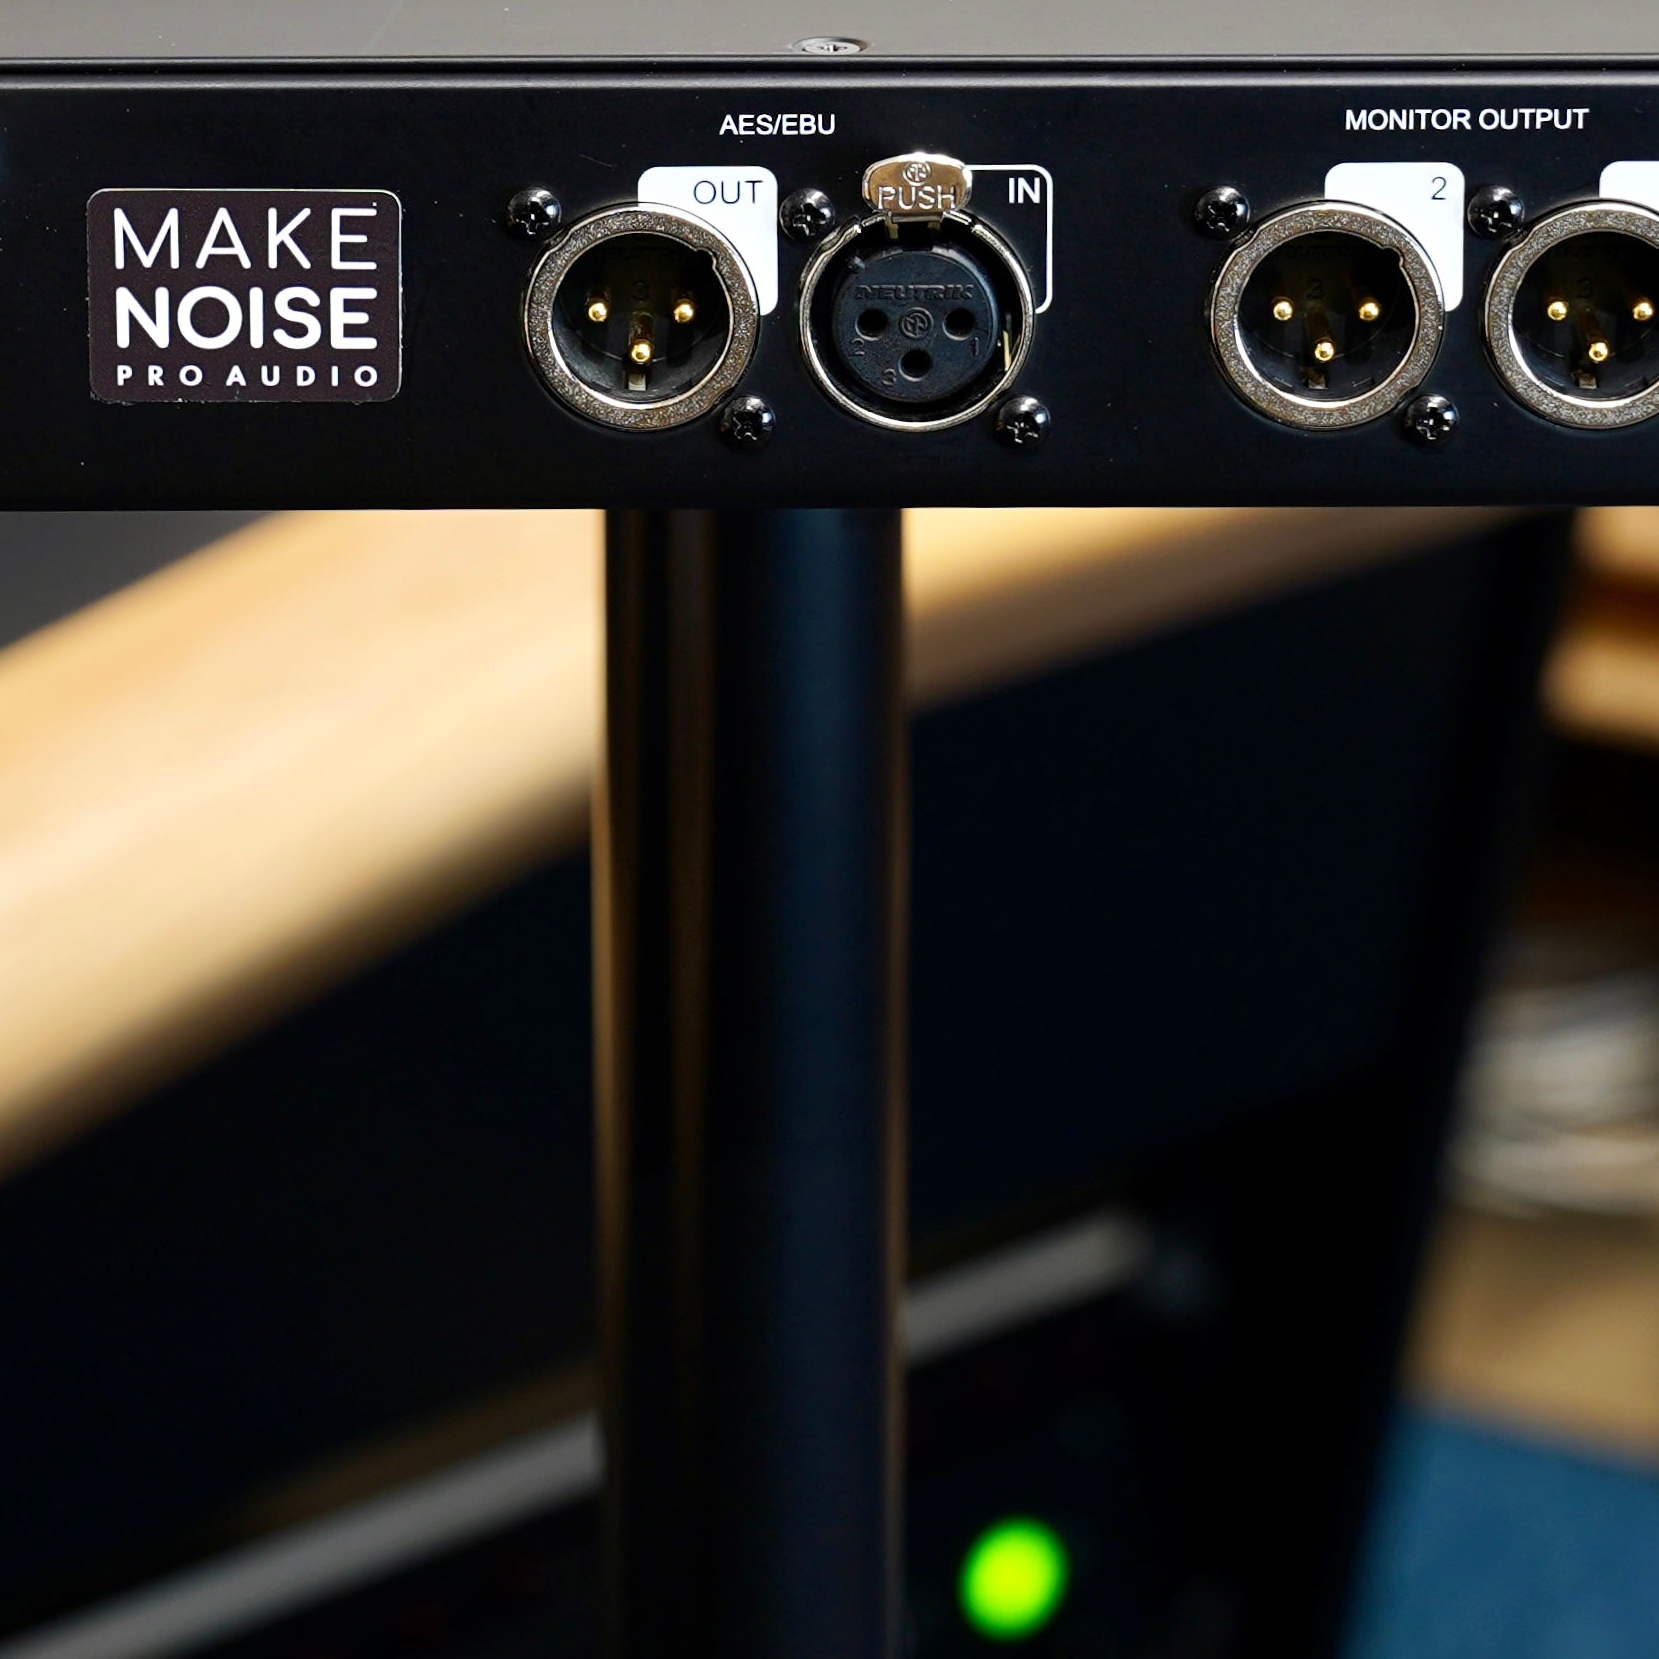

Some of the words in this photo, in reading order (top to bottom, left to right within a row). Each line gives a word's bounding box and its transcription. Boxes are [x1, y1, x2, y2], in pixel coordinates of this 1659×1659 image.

[718, 113, 836, 136] AES/EBU
[1345, 108, 1472, 131] MONITOR
[1479, 107, 1590, 131] OUTPUT
[693, 180, 763, 205] OUT
[877, 185, 957, 211] PUSH
[1008, 177, 1041, 204] IN
[1431, 176, 1447, 201] 2
[113, 205, 378, 271] MAKE
[854, 284, 974, 300] NEUTRIK
[115, 285, 378, 350] NOISE
[116, 364, 203, 387] PRO
[225, 364, 378, 388] AUDIO
